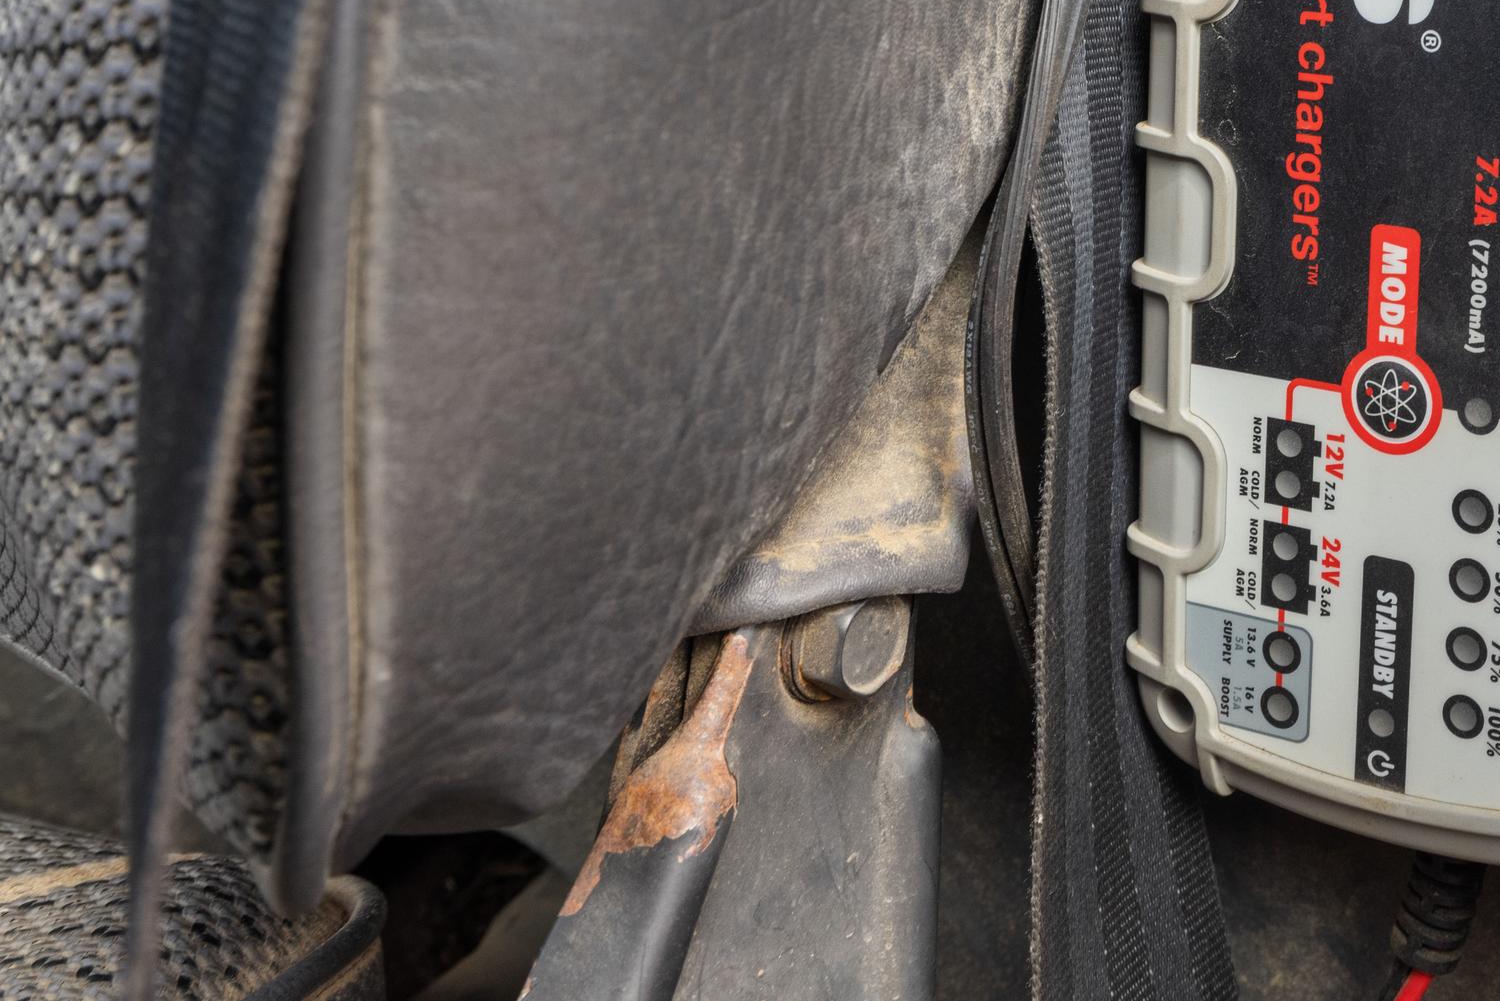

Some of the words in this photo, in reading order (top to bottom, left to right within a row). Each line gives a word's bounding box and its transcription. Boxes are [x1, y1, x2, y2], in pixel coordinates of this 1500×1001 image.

[1473, 155, 1500, 226] 7.2A
[1378, 241, 1408, 346] MODE
[1463, 239, 1491, 354] (7200mA)
[1252, 417, 1262, 454] NORM
[1325, 433, 1345, 479] 12V
[1239, 468, 1249, 496] AGM
[1249, 471, 1260, 510] COLD/
[1324, 481, 1336, 511] 7.2A
[1248, 518, 1258, 555] NORM
[1321, 536, 1341, 587] 24V
[1235, 568, 1245, 597] AGM
[1245, 571, 1257, 610] COLD/
[1320, 586, 1332, 617] 3.6A
[1222, 620, 1232, 665] SUPPLY
[1247, 627, 1256, 655] 13.6
[1372, 590, 1398, 700] STANDBY
[1246, 659, 1255, 667] V
[1221, 677, 1231, 718] BOOST
[1245, 686, 1254, 700] 16
[1245, 704, 1254, 713] V
